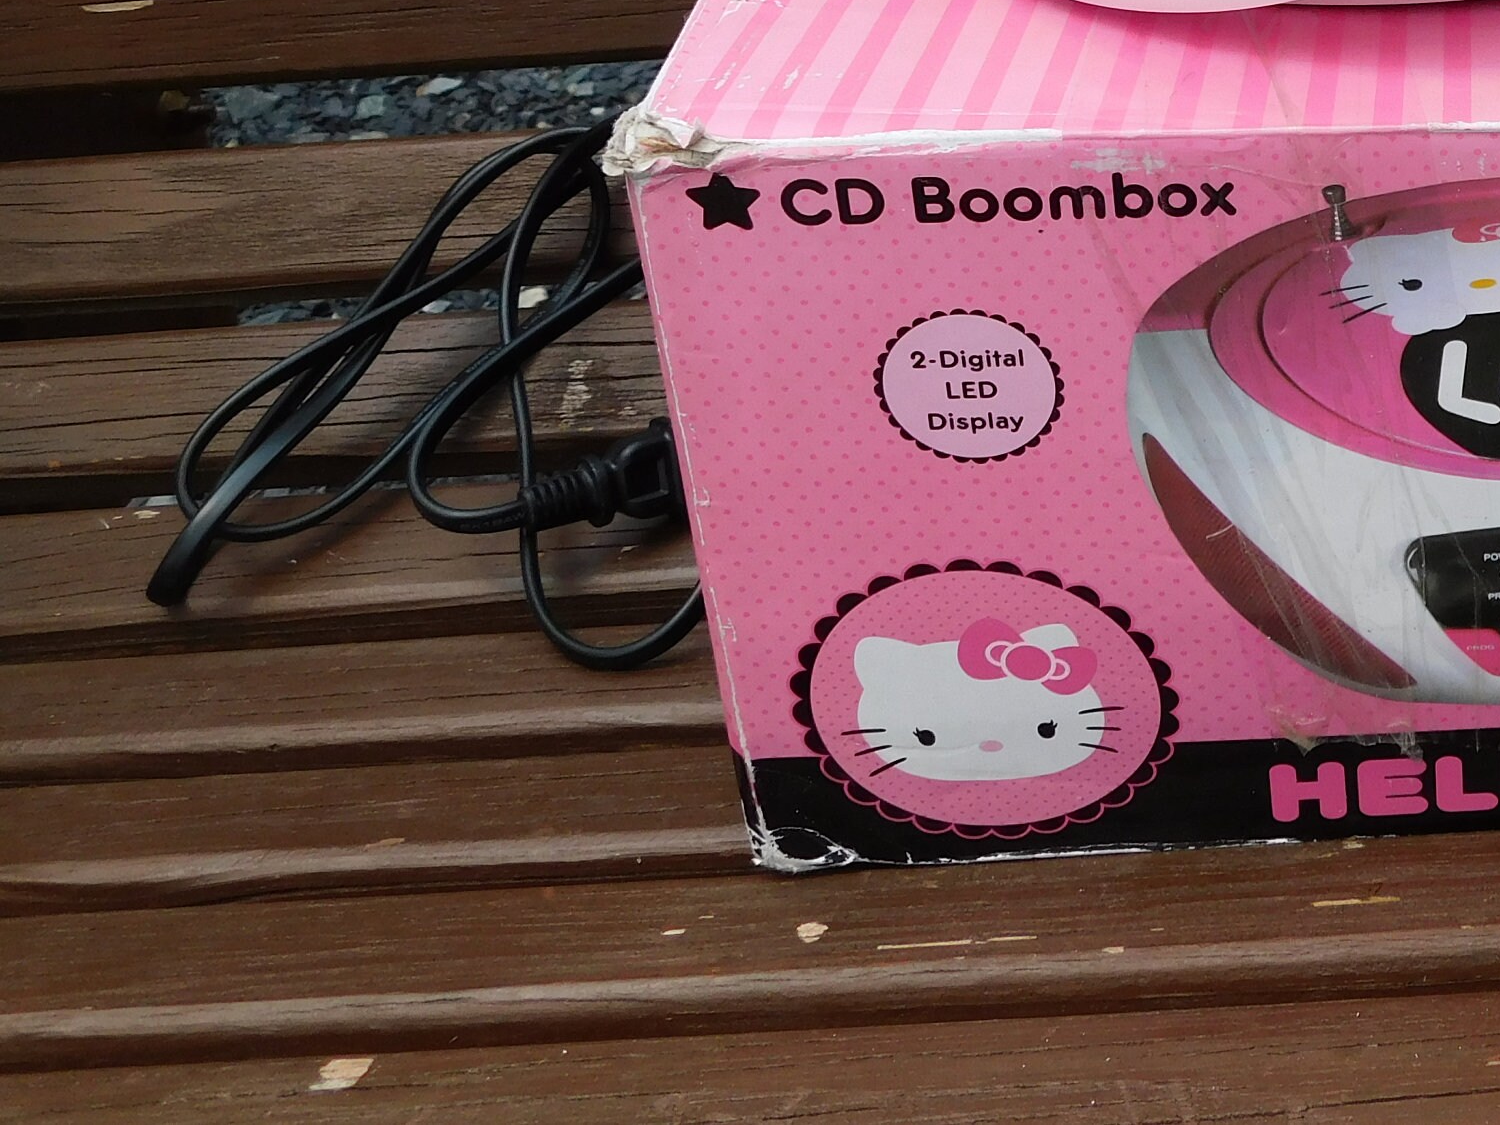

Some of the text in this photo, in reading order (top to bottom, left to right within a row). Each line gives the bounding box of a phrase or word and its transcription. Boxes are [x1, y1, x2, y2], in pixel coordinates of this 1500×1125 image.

[780, 172, 1238, 226] CD Boombox
[909, 348, 1026, 372] 2-Digital
[945, 380, 998, 401] LED
[927, 412, 1025, 434] Display
